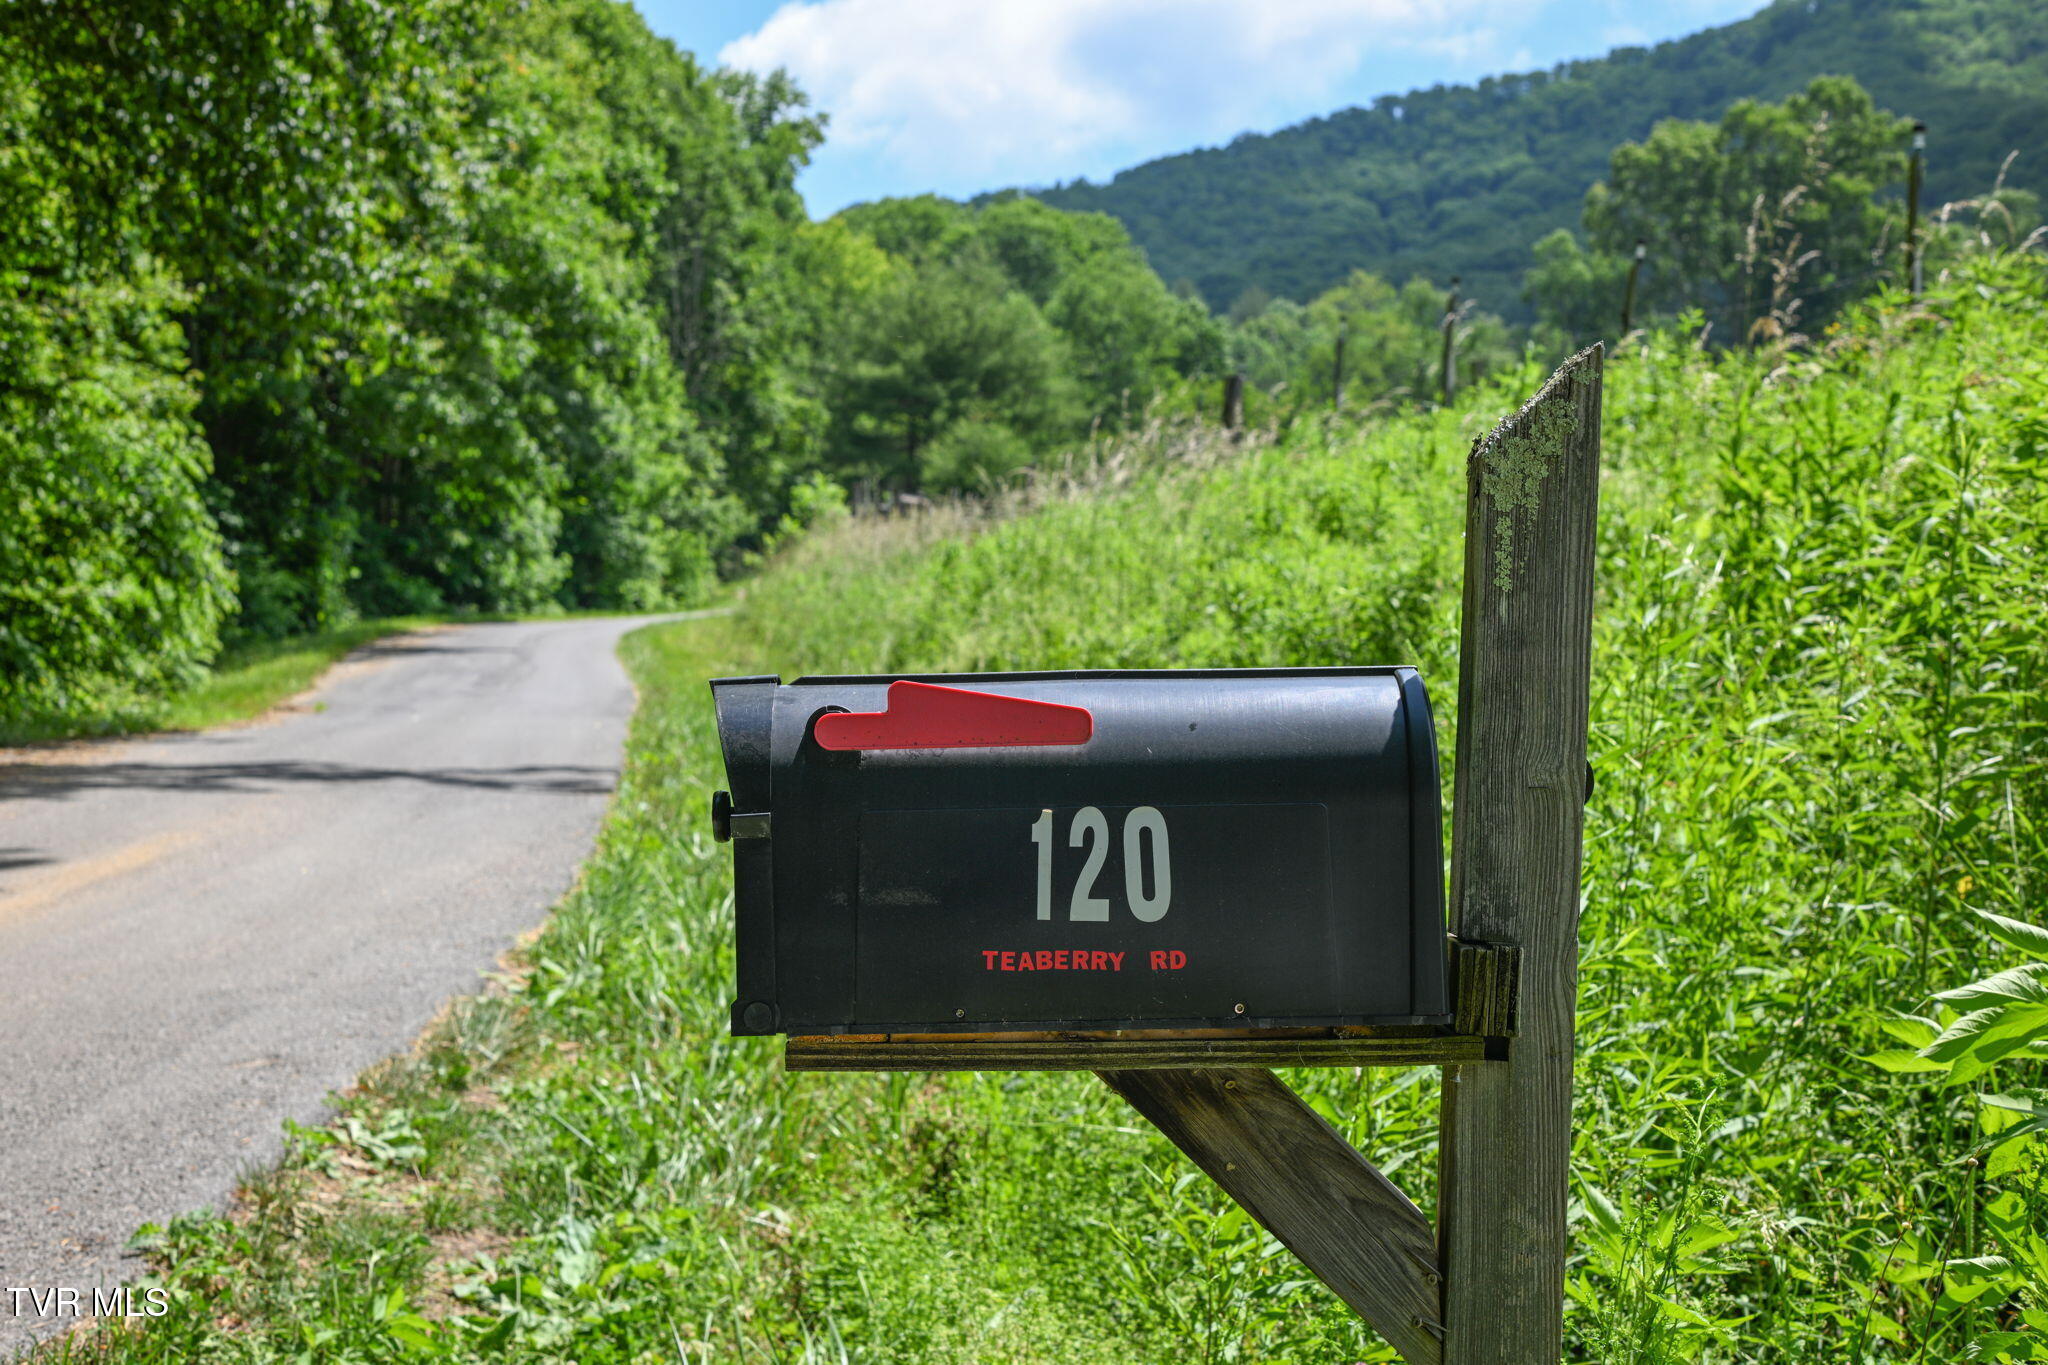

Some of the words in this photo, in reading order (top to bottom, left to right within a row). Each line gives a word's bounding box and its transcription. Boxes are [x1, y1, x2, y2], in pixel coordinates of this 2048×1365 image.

[1031, 806, 1172, 923] 120
[982, 950, 1125, 972] TEABERRY
[1150, 950, 1187, 970] RD
